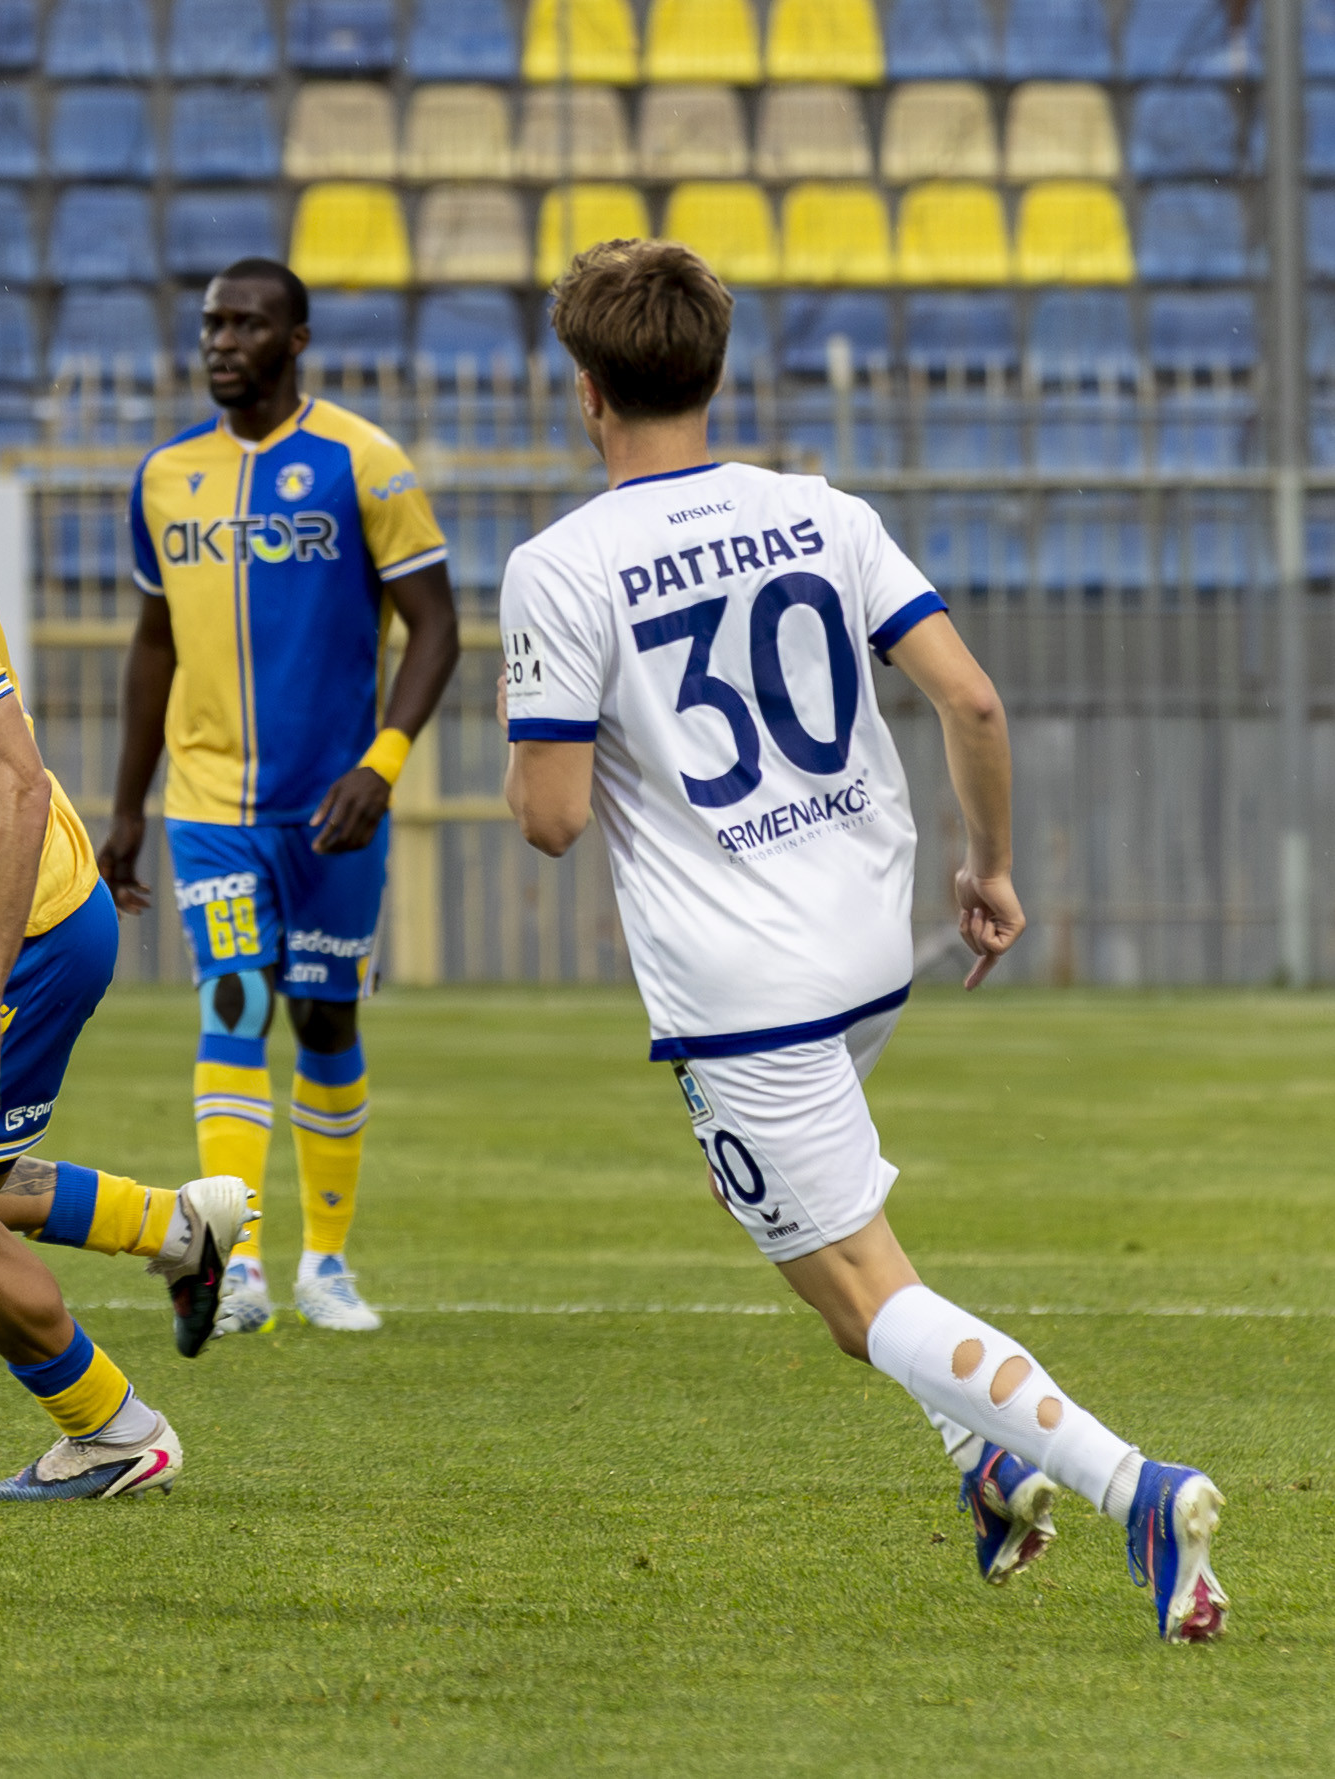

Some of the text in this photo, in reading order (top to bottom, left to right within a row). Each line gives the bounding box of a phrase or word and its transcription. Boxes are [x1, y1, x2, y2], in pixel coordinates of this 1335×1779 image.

[666, 500, 736, 525] KIFISIA FC
[619, 518, 825, 606] PATIRAS
[631, 572, 859, 809] 30
[205, 896, 261, 960] 69
